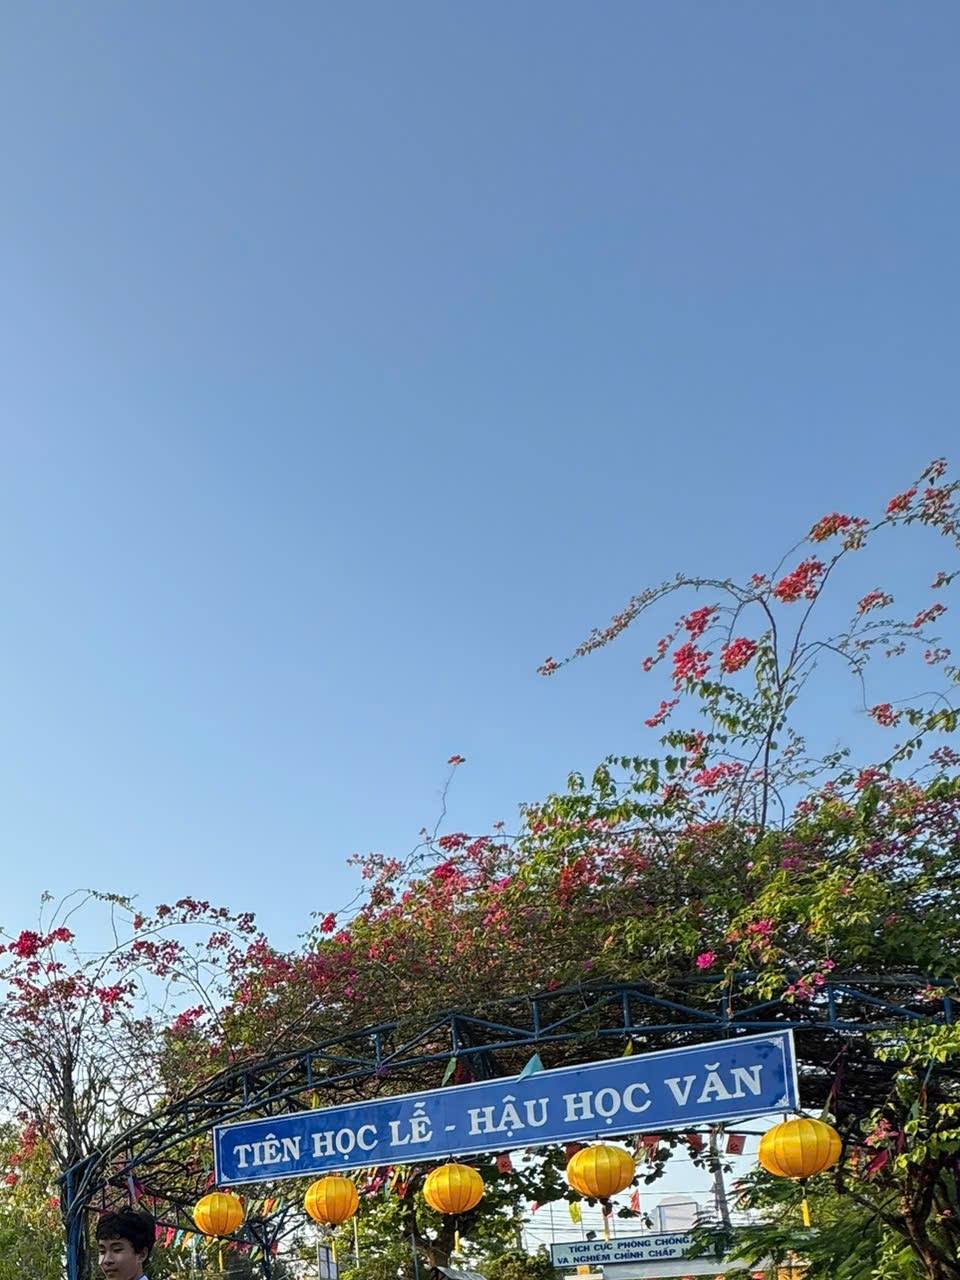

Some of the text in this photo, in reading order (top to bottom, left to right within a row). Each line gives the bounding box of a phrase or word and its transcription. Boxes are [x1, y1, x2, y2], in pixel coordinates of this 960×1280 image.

[233, 1132, 302, 1169] TIÊN
[311, 1124, 378, 1160] HỌC
[388, 1101, 433, 1147] LỄ
[467, 1095, 549, 1137] HẬU
[563, 1082, 652, 1125] HỌC
[664, 1062, 763, 1108] VĂN
